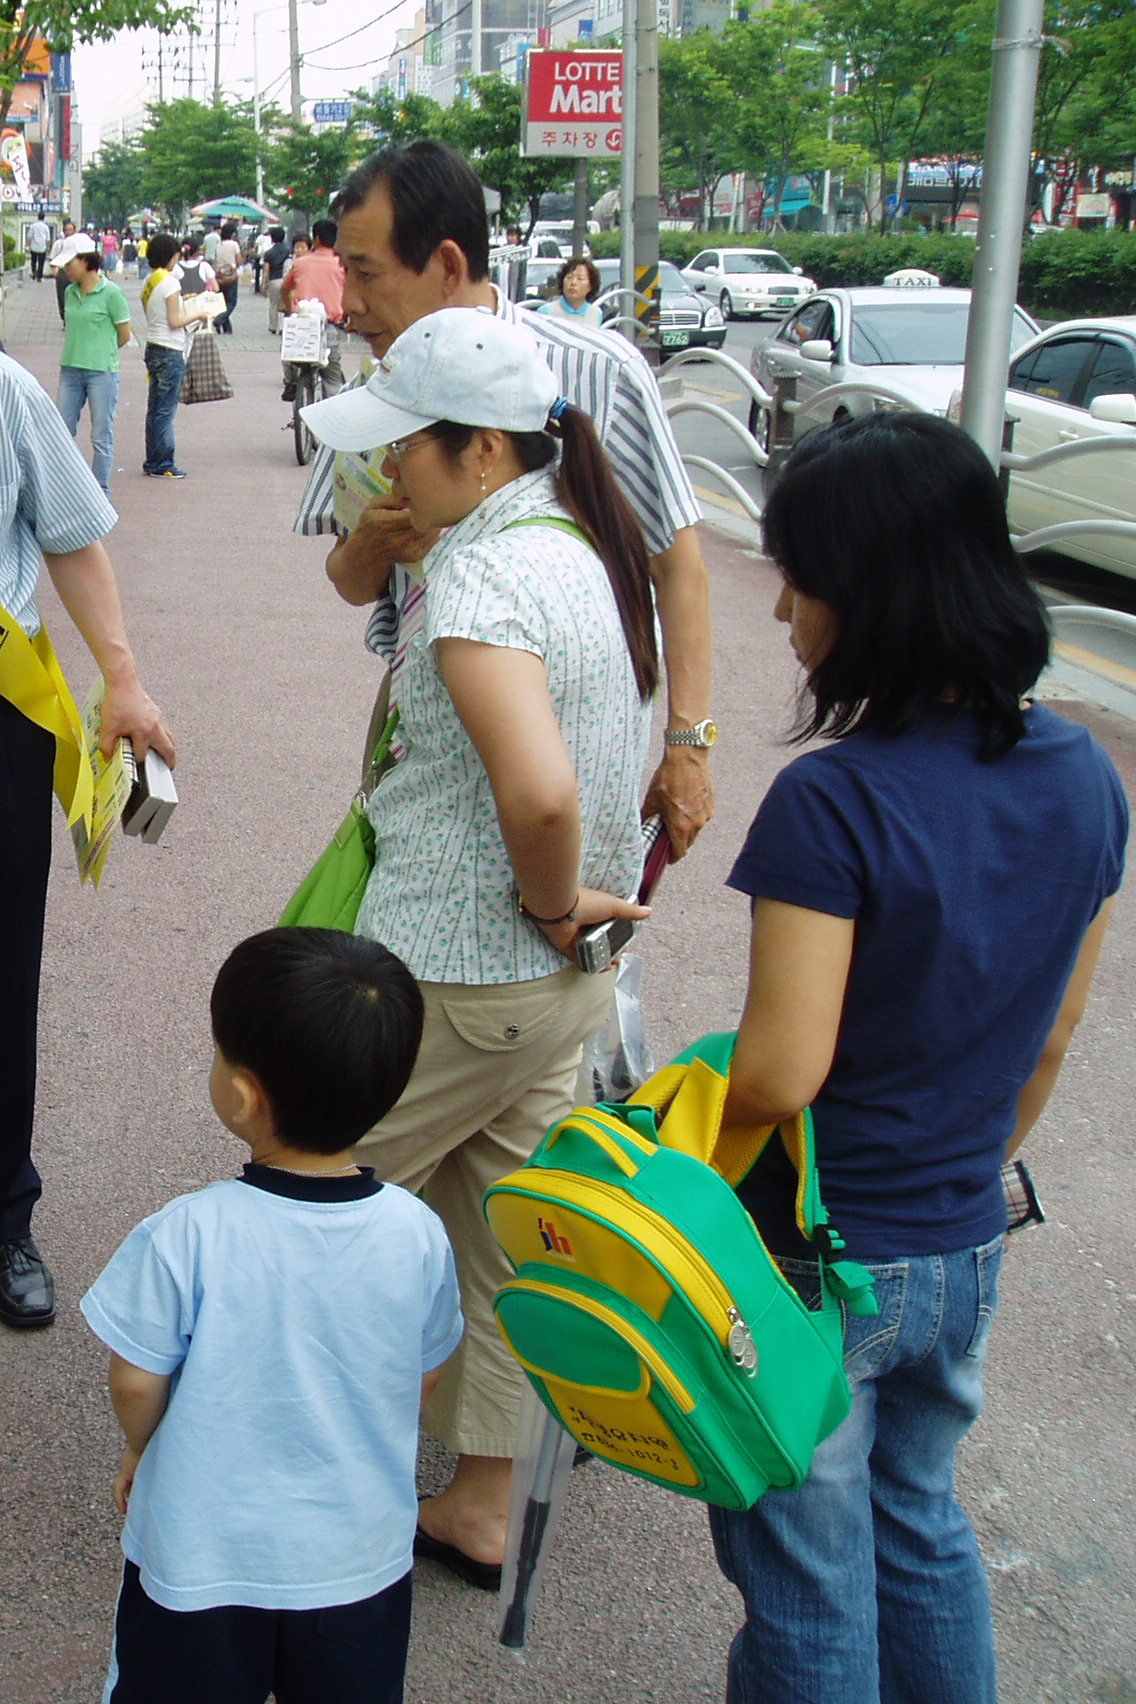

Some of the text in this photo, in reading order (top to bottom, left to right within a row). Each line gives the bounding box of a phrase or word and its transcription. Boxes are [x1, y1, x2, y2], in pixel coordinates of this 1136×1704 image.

[554, 62, 620, 81] LOTTE
[549, 84, 623, 113] Mart
[542, 131, 599, 149] 주차장
[896, 277, 932, 286] TAXI
